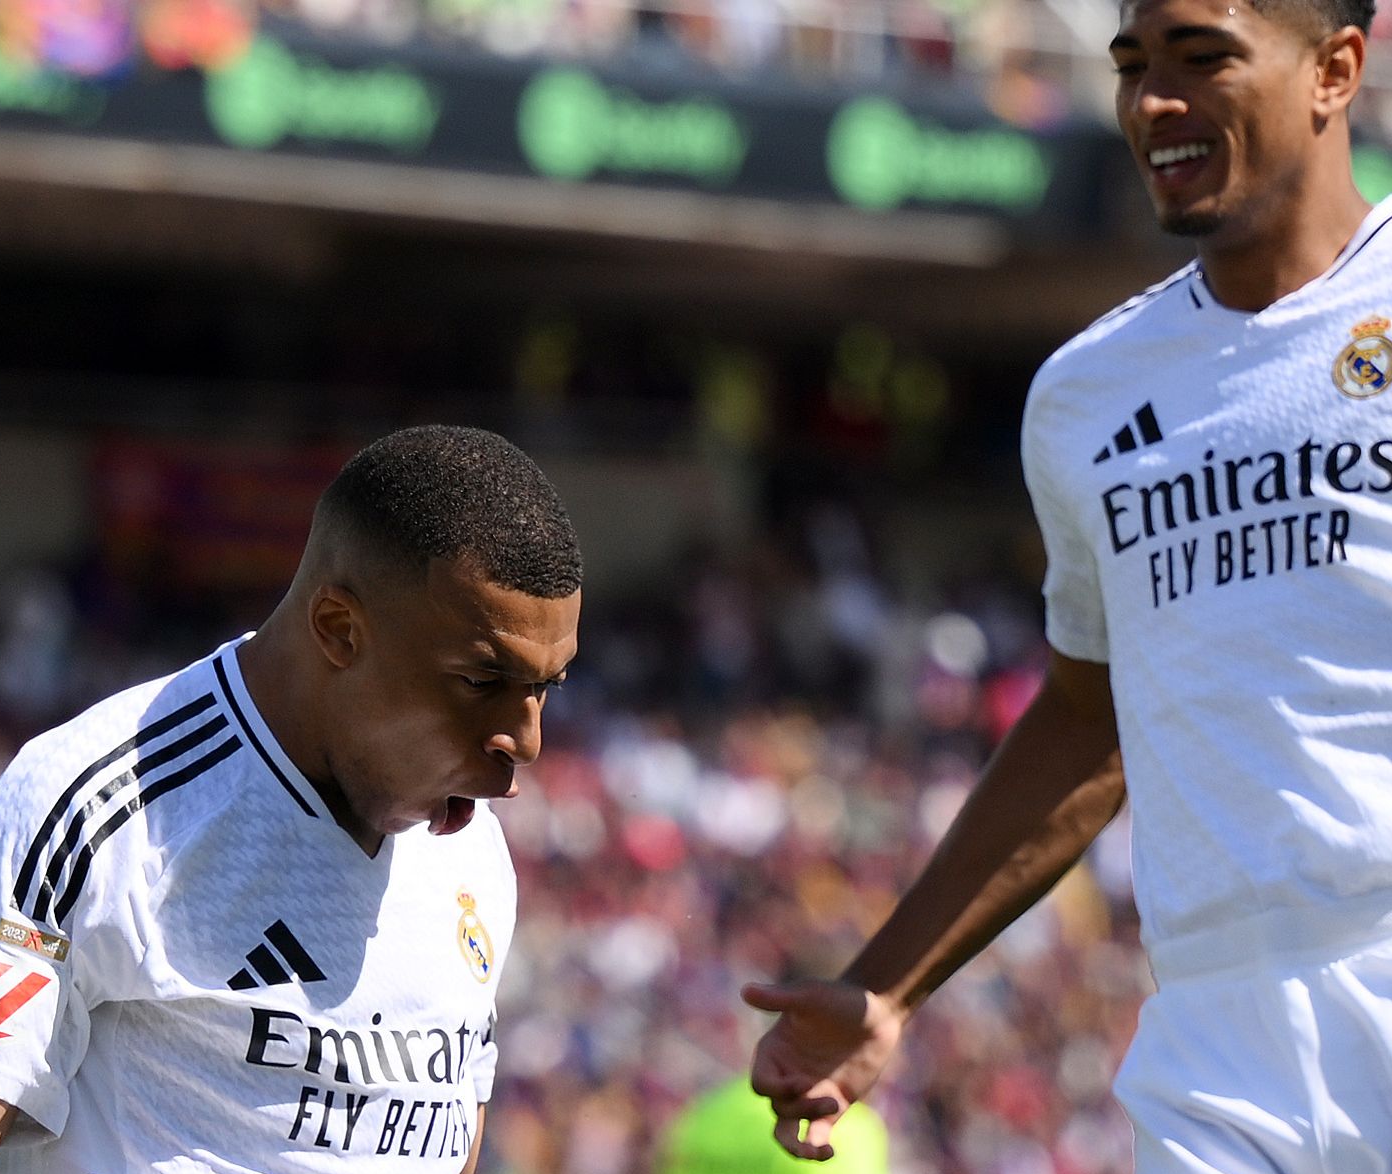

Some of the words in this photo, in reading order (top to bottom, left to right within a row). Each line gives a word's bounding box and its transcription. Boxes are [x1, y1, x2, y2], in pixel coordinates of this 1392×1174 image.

[1148, 539, 1200, 608] FLY
[1215, 509, 1351, 587] BETTER
[245, 1006, 495, 1085] Emirat
[288, 1085, 369, 1151] FLY
